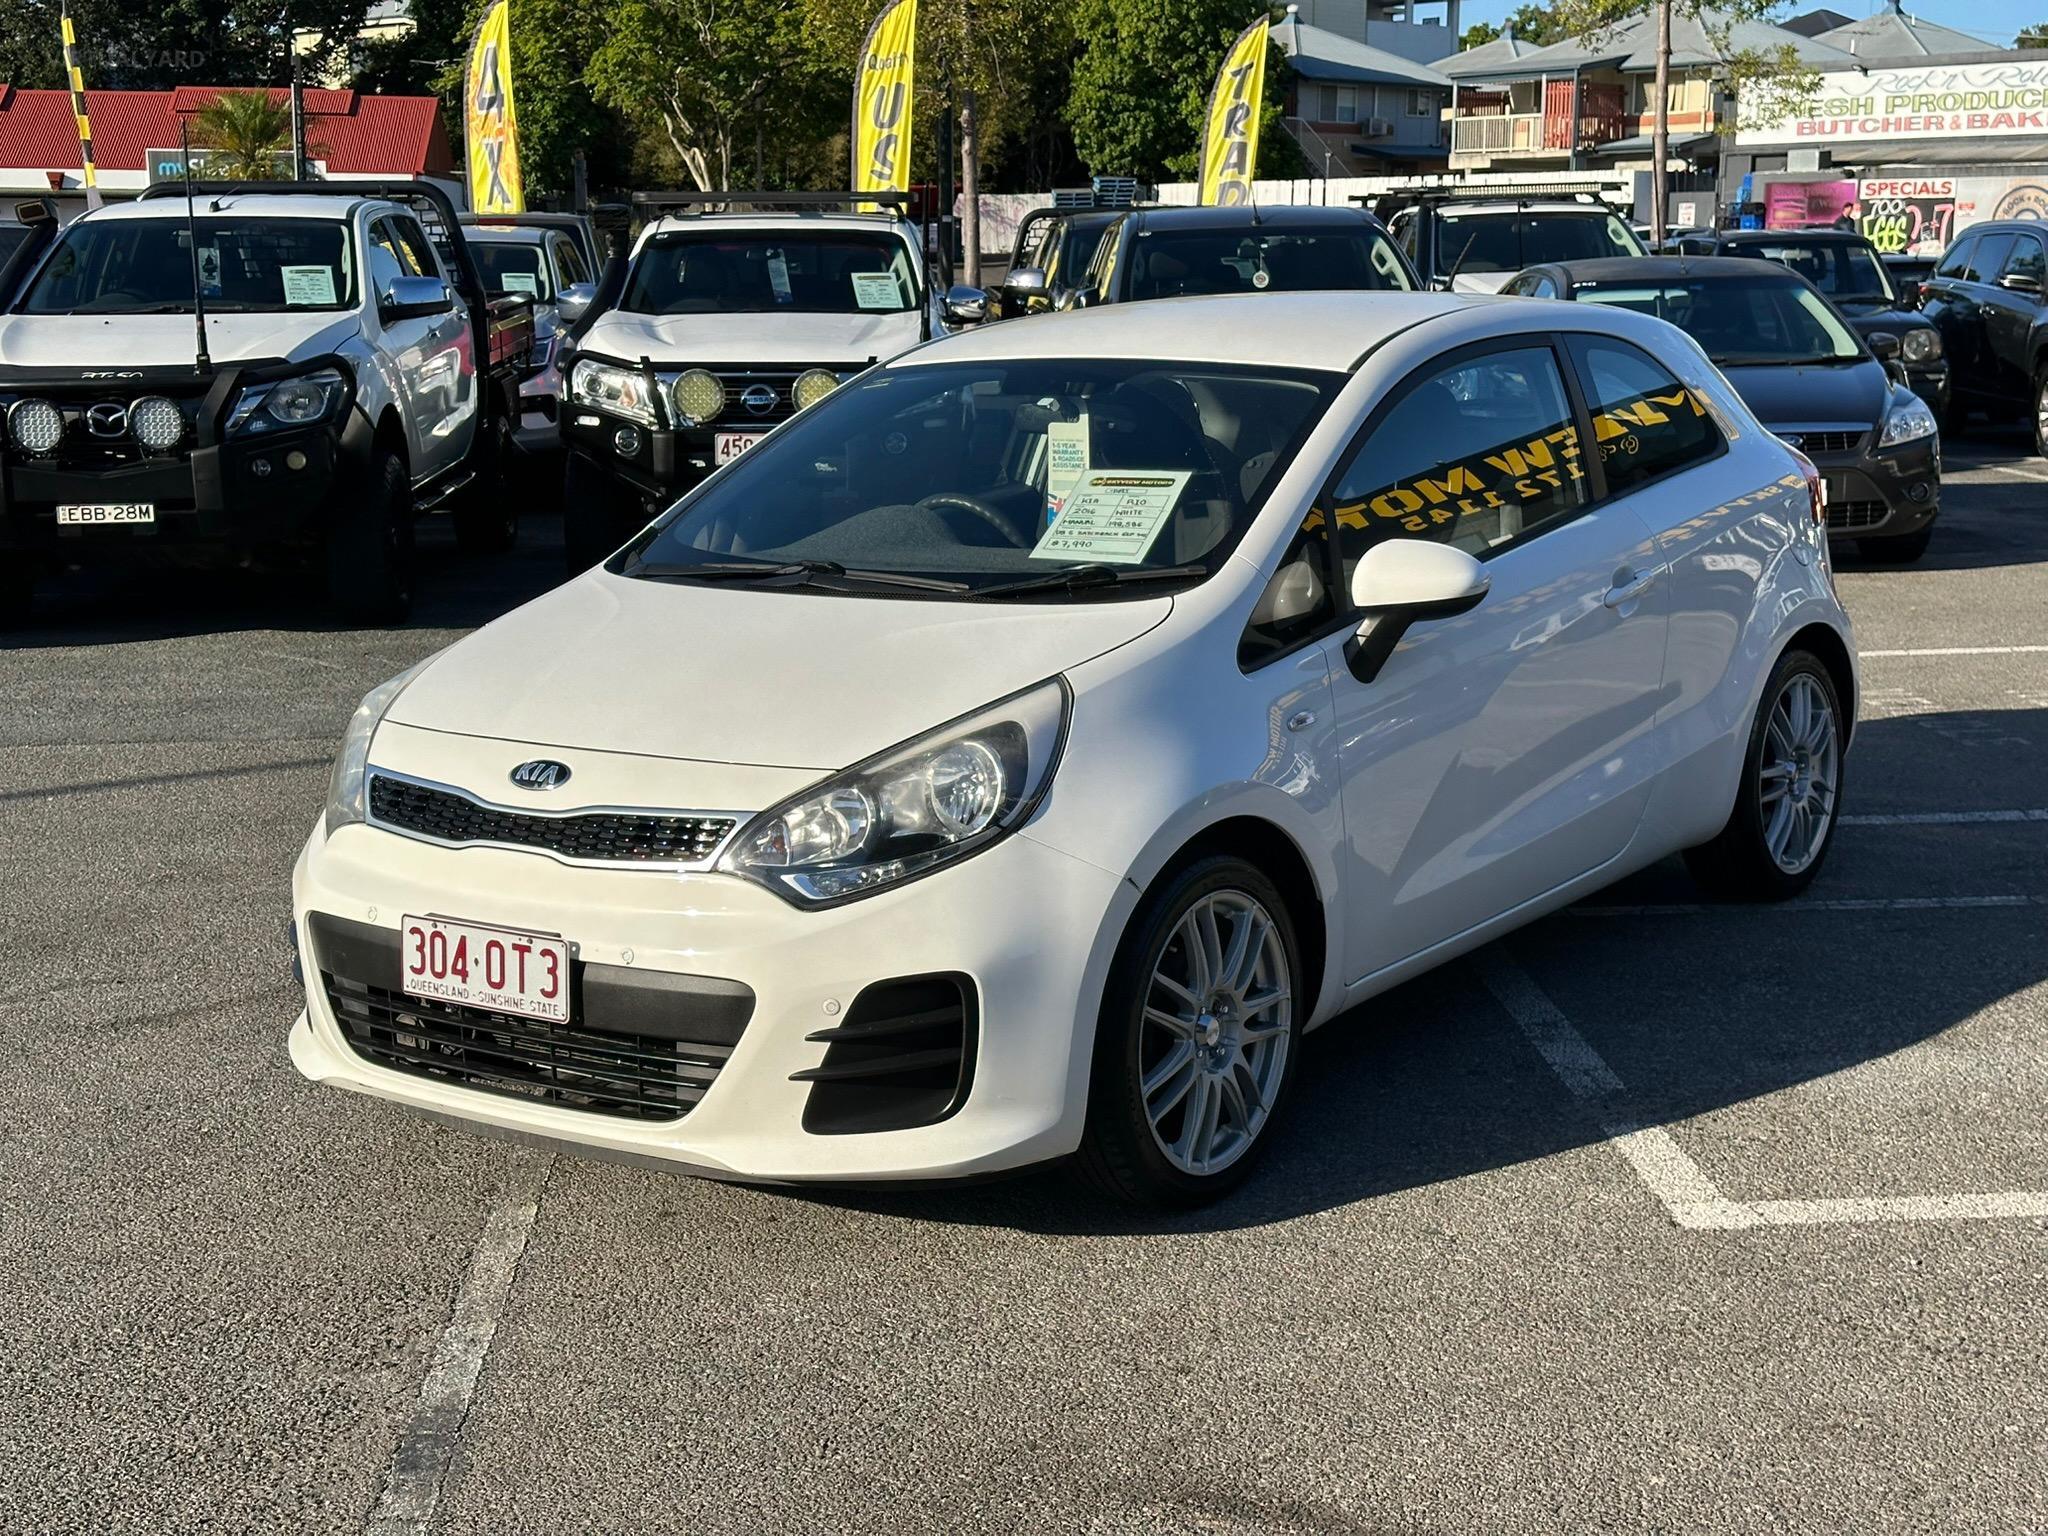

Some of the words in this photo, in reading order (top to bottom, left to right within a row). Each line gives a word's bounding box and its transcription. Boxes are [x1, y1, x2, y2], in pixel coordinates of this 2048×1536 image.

[1885, 88, 2048, 114] PRODUC
[871, 82, 906, 191] US
[1796, 115, 1945, 137] BUTCHER
[1950, 115, 1961, 130] &
[1967, 111, 2048, 129] BAK
[1865, 182, 1952, 196] SPECIALS
[1126, 499, 1147, 507] RIO
[515, 762, 560, 785] KIA
[410, 978, 470, 999] QUEENSLAND
[479, 991, 526, 1011] SUNSHINE
[530, 1001, 559, 1016] STATE
